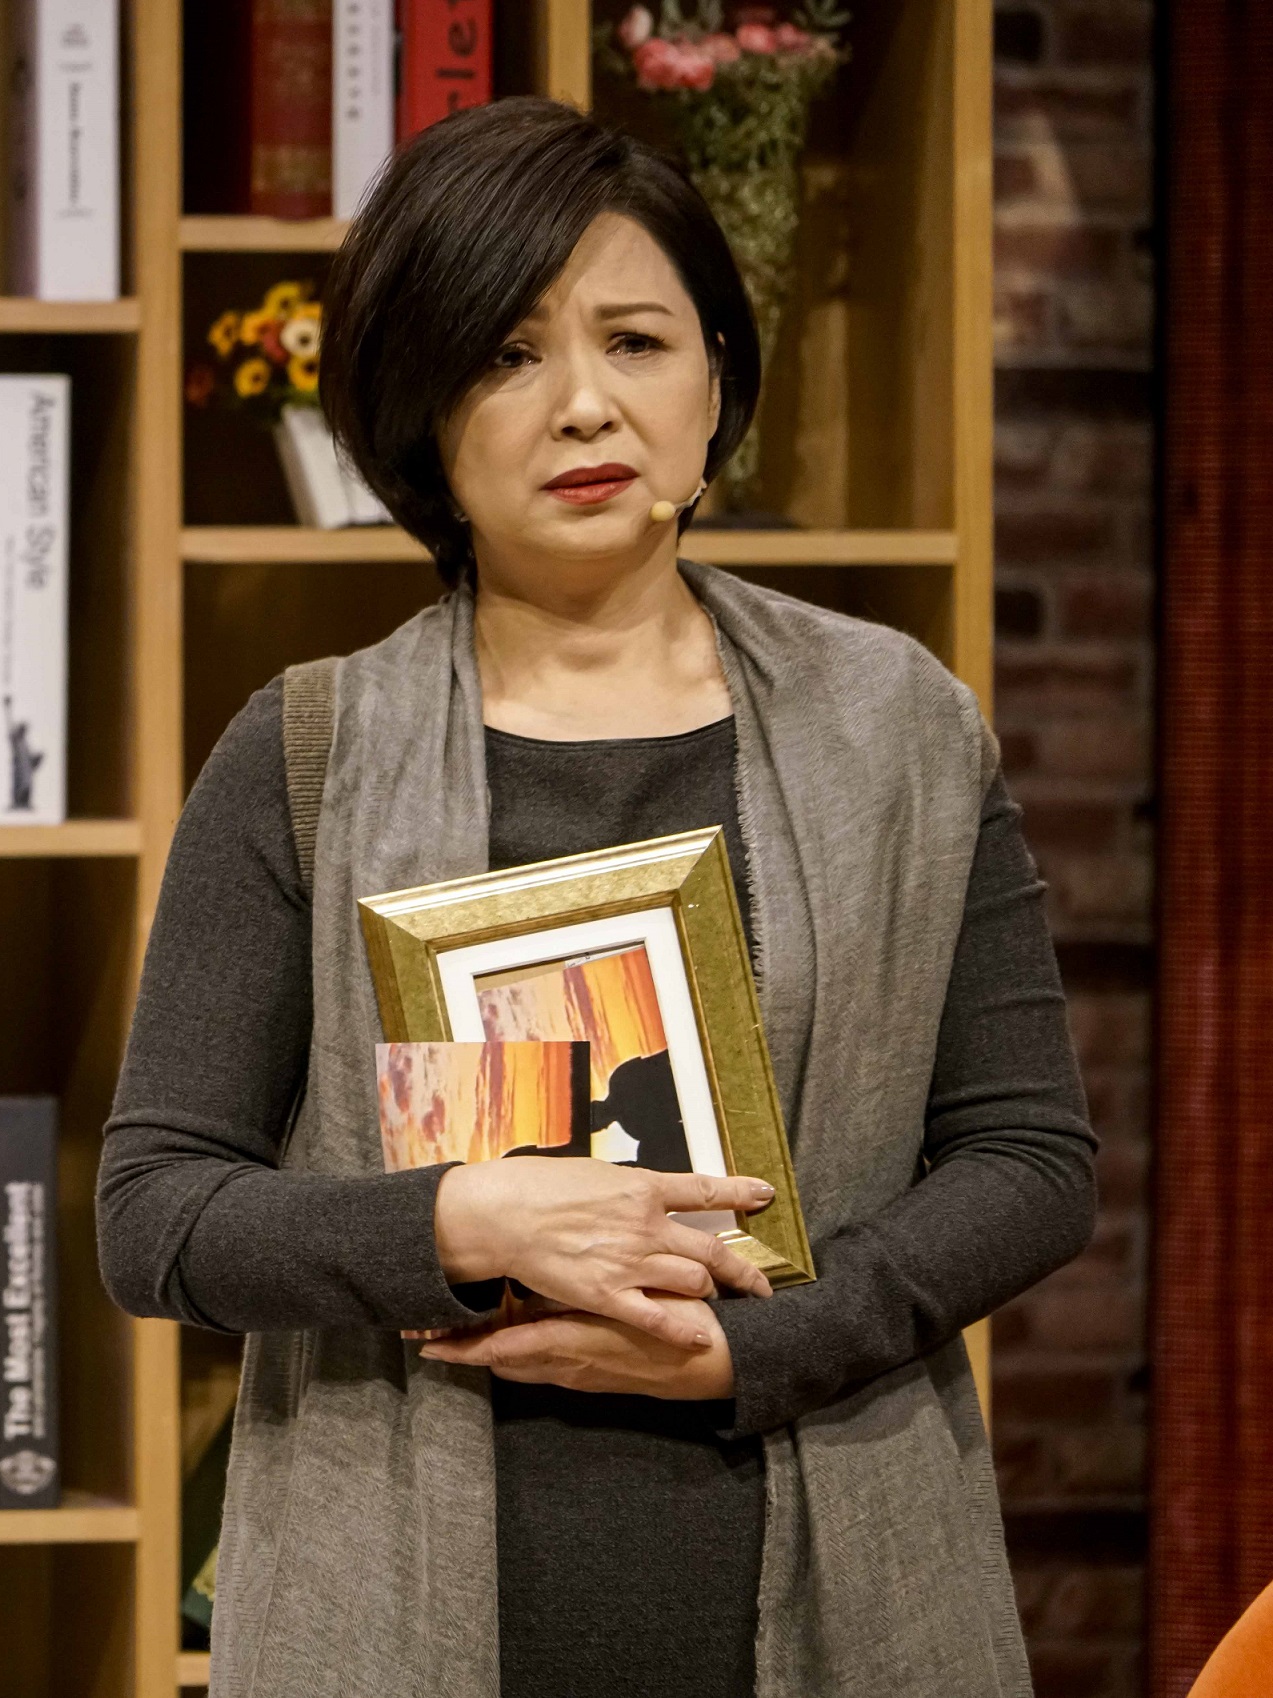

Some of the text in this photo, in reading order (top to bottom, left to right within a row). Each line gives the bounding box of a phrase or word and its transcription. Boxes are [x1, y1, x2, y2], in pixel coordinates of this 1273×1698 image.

[20, 391, 56, 588] American Style
[4, 1182, 32, 1440] The Most Excellent
